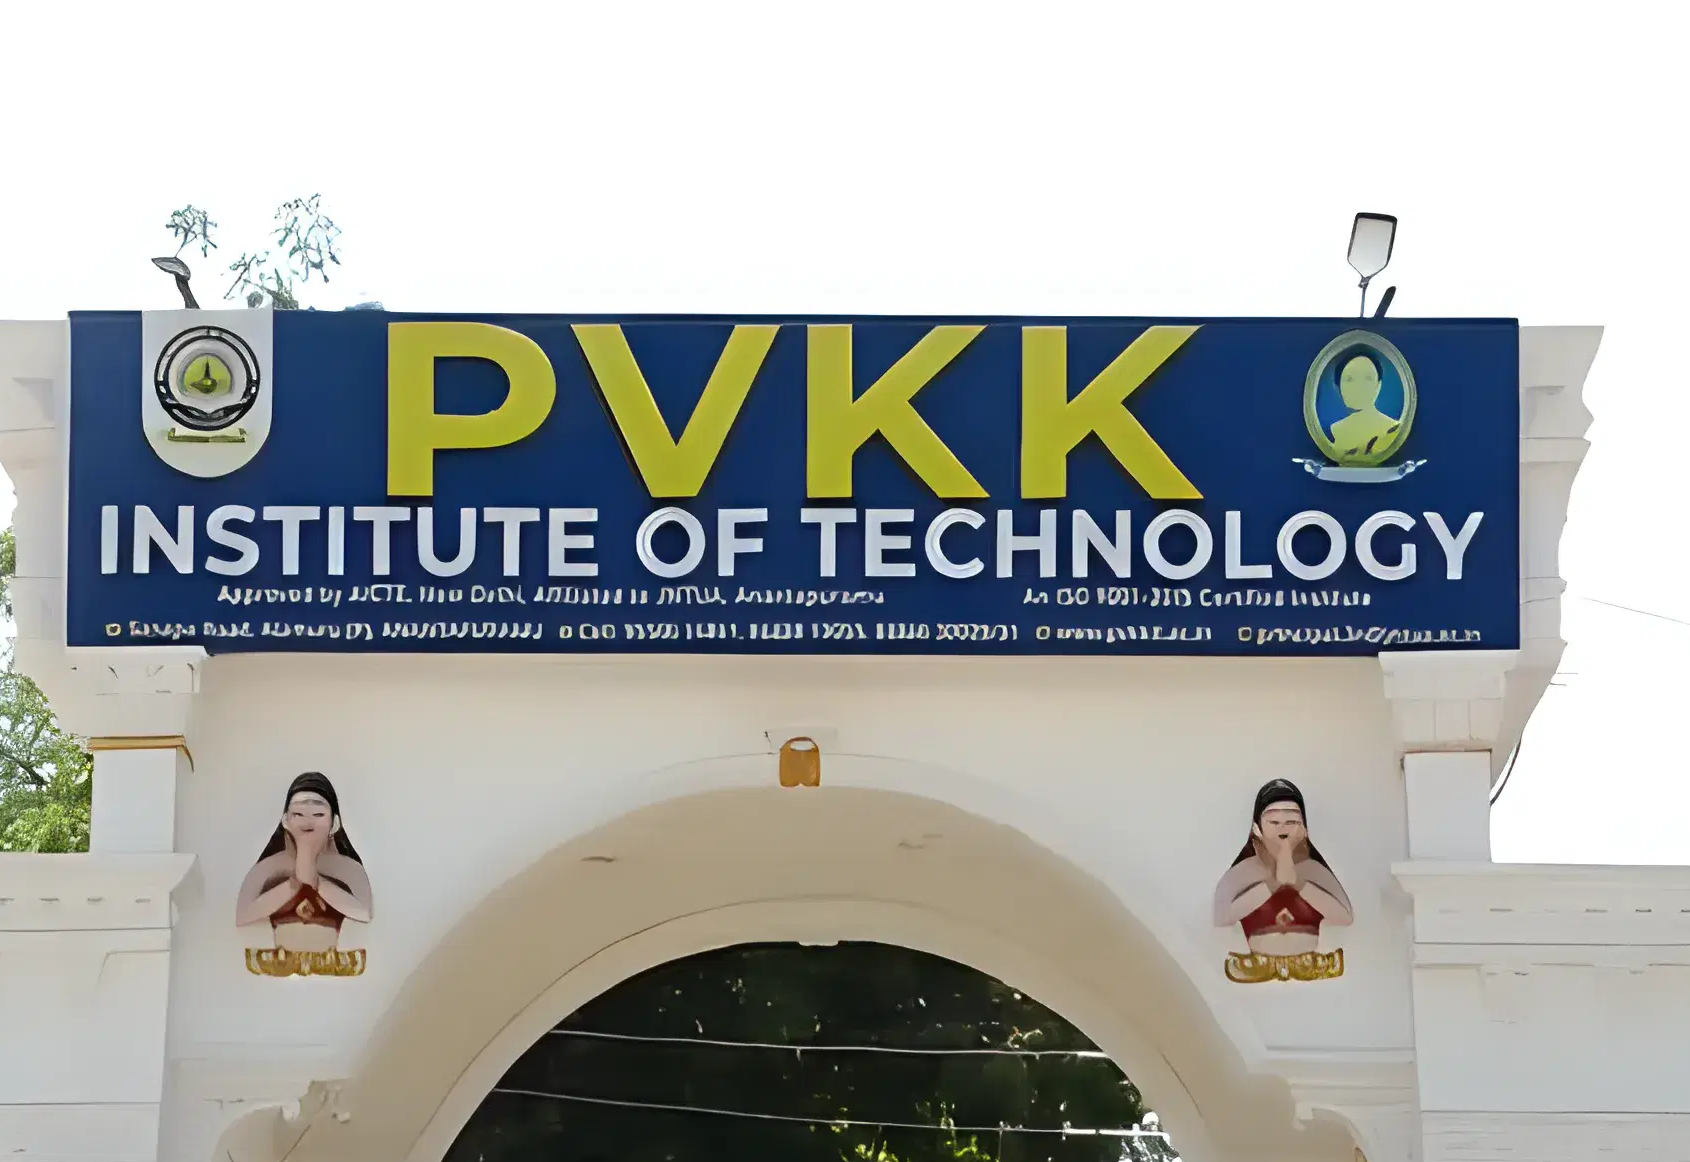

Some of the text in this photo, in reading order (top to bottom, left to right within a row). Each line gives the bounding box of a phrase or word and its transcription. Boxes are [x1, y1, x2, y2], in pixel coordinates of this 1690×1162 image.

[386, 322, 1203, 501] PVKK
[100, 503, 1486, 582] INSTITUTE OF TECHNOLOGY
